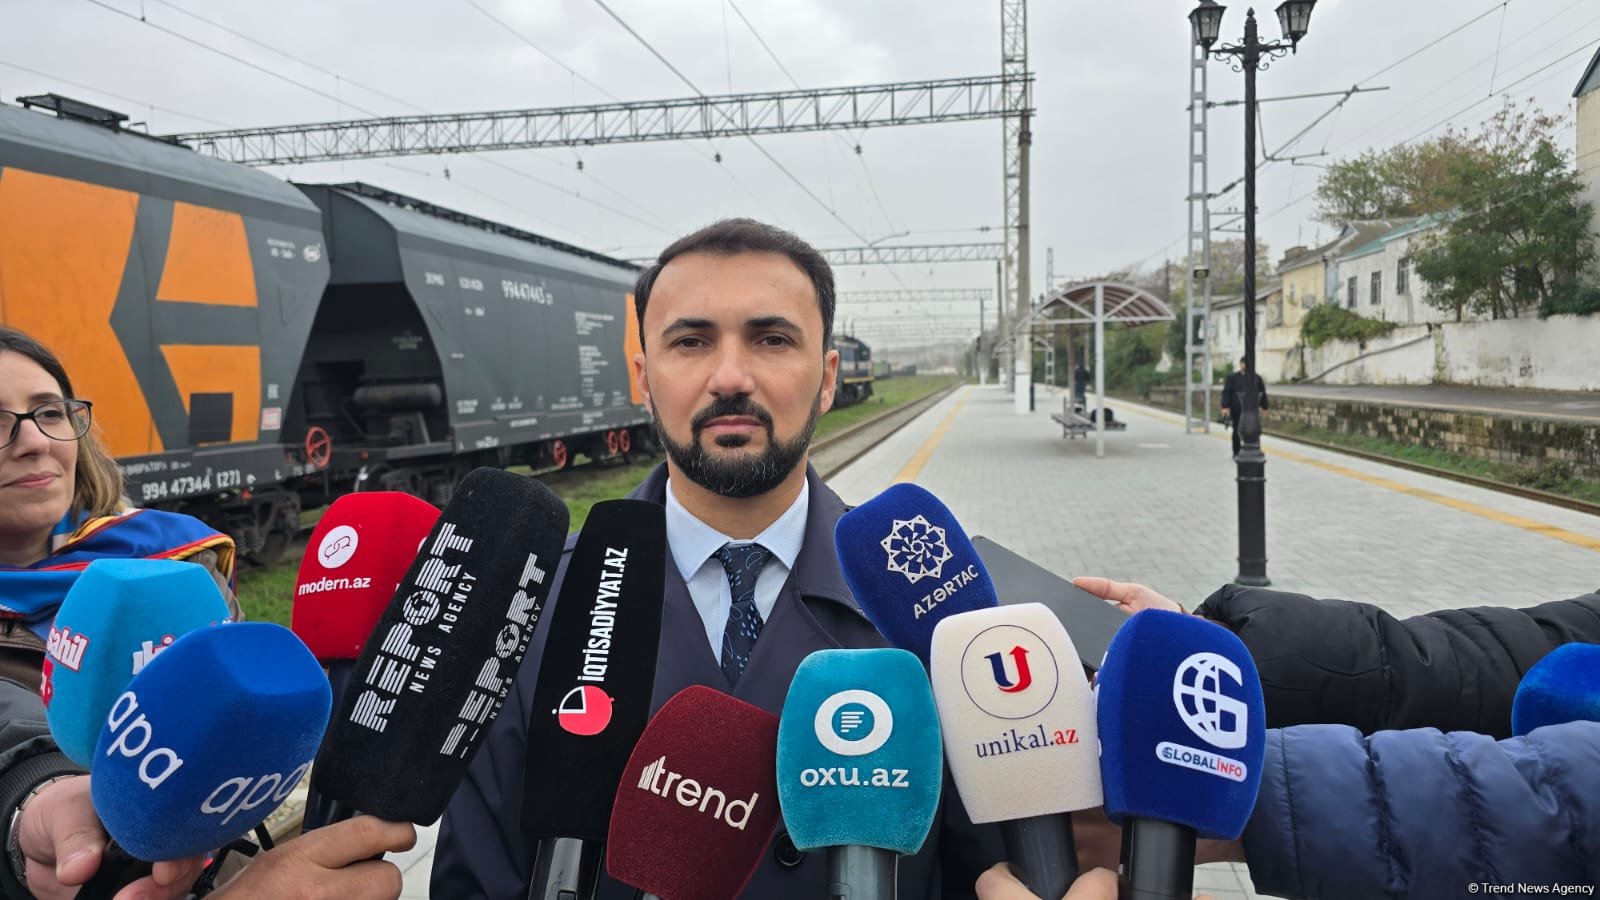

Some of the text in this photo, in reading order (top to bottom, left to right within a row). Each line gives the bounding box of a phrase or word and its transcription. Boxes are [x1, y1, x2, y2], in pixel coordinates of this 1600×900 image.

[142, 481, 168, 500] 994
[170, 475, 211, 494] 47344
[298, 576, 372, 596] modern.az
[913, 564, 979, 620] AZƏRTAC
[350, 522, 474, 733] REPORT
[409, 571, 477, 694] NEWS AGENCY
[107, 691, 184, 790] apa
[975, 724, 1079, 758] unikal.az
[200, 759, 314, 826] apa
[638, 755, 759, 831] trend
[800, 766, 910, 788] oxu.az
